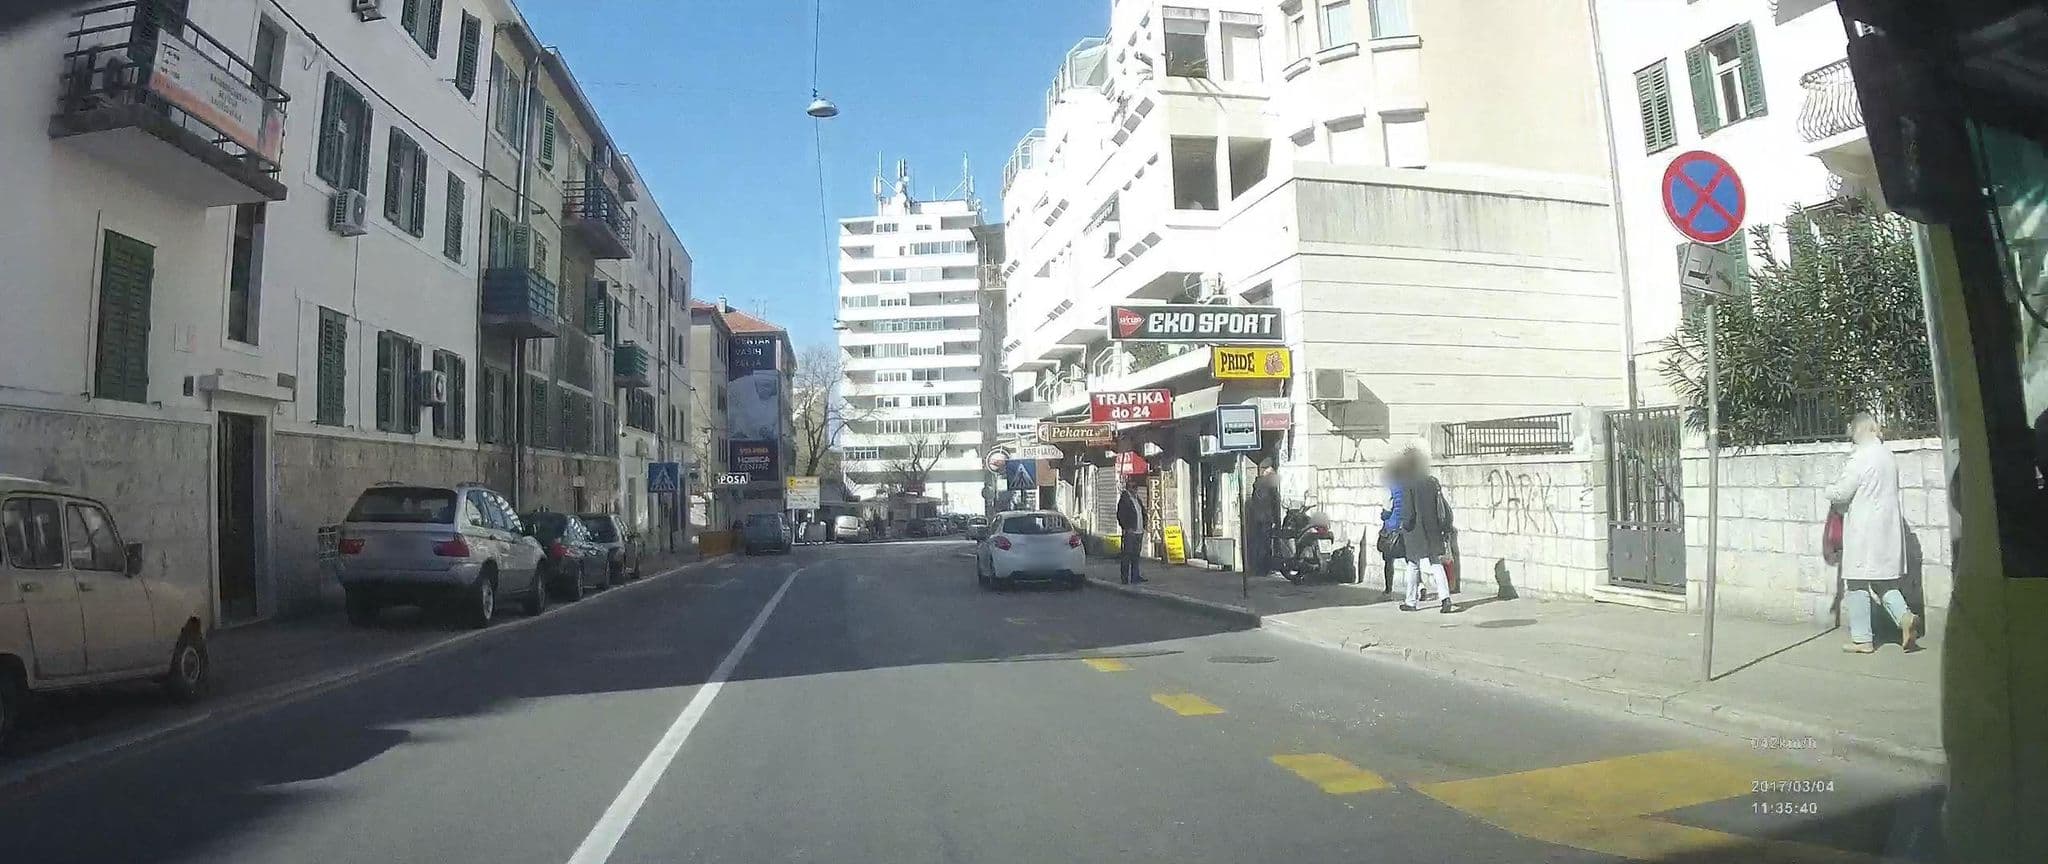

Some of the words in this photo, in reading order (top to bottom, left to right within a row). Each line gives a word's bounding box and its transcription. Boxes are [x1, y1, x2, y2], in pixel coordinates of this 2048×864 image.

[1148, 312, 1195, 334] EKO
[1199, 312, 1278, 335] SPORT
[1220, 351, 1255, 373] PRIDE
[1096, 391, 1165, 406] TRAFIKA
[1111, 406, 1130, 418] do
[1132, 405, 1151, 418] 24
[1051, 426, 1095, 438] Pekara
[1150, 479, 1162, 541] PEKARA
[1488, 469, 1559, 534] PARK
